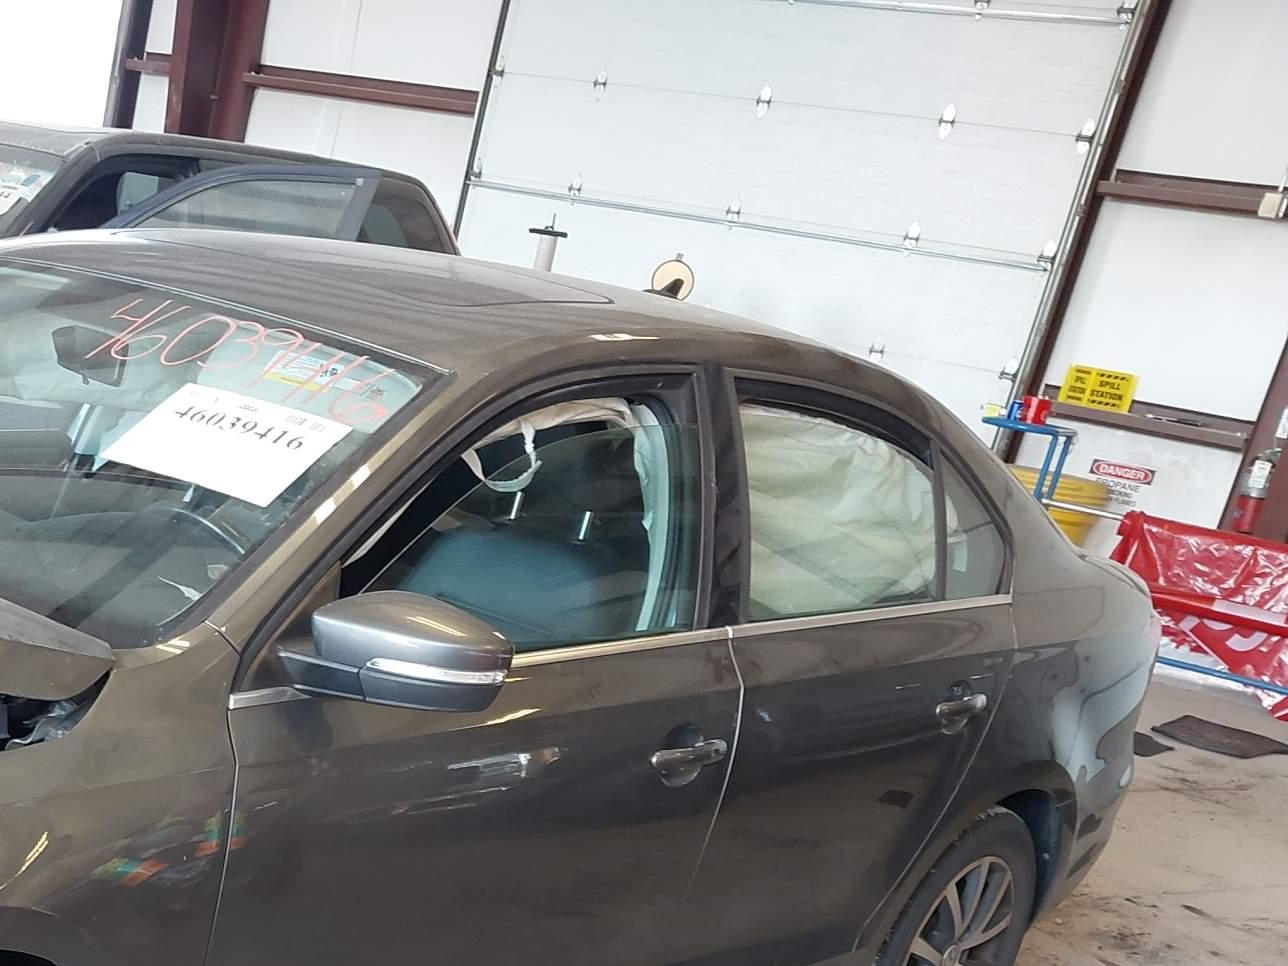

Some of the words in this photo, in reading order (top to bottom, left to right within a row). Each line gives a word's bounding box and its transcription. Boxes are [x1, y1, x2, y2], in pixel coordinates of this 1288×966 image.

[1098, 379, 1122, 391] SPILL
[1089, 389, 1124, 402] STATION
[175, 405, 305, 450] 46039416
[1098, 463, 1146, 481] DANGER
